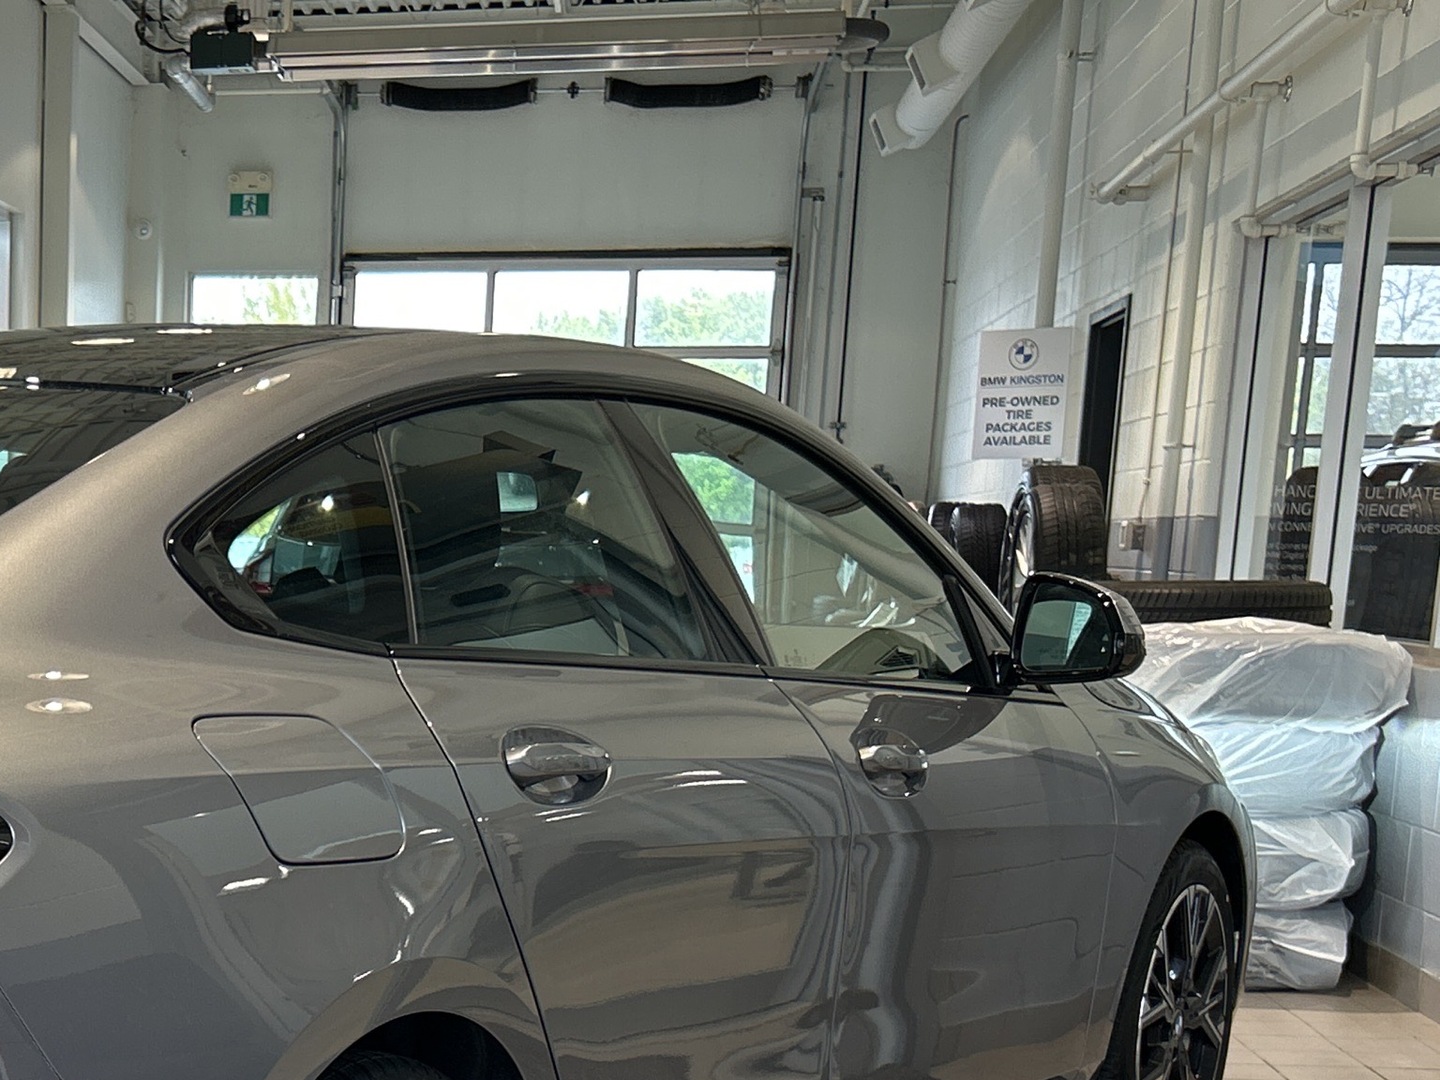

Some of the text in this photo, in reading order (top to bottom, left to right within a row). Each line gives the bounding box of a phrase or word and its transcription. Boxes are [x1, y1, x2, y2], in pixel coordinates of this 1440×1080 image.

[980, 374, 1064, 386] BMW KINGSTON
[982, 395, 1060, 408] PRE-OWNED
[1006, 409, 1033, 420] TIRE
[985, 421, 1052, 433] PACKAGES
[983, 435, 1051, 446] AVAILABLE
[1274, 484, 1316, 498] HANC
[1272, 502, 1312, 516] IVING
